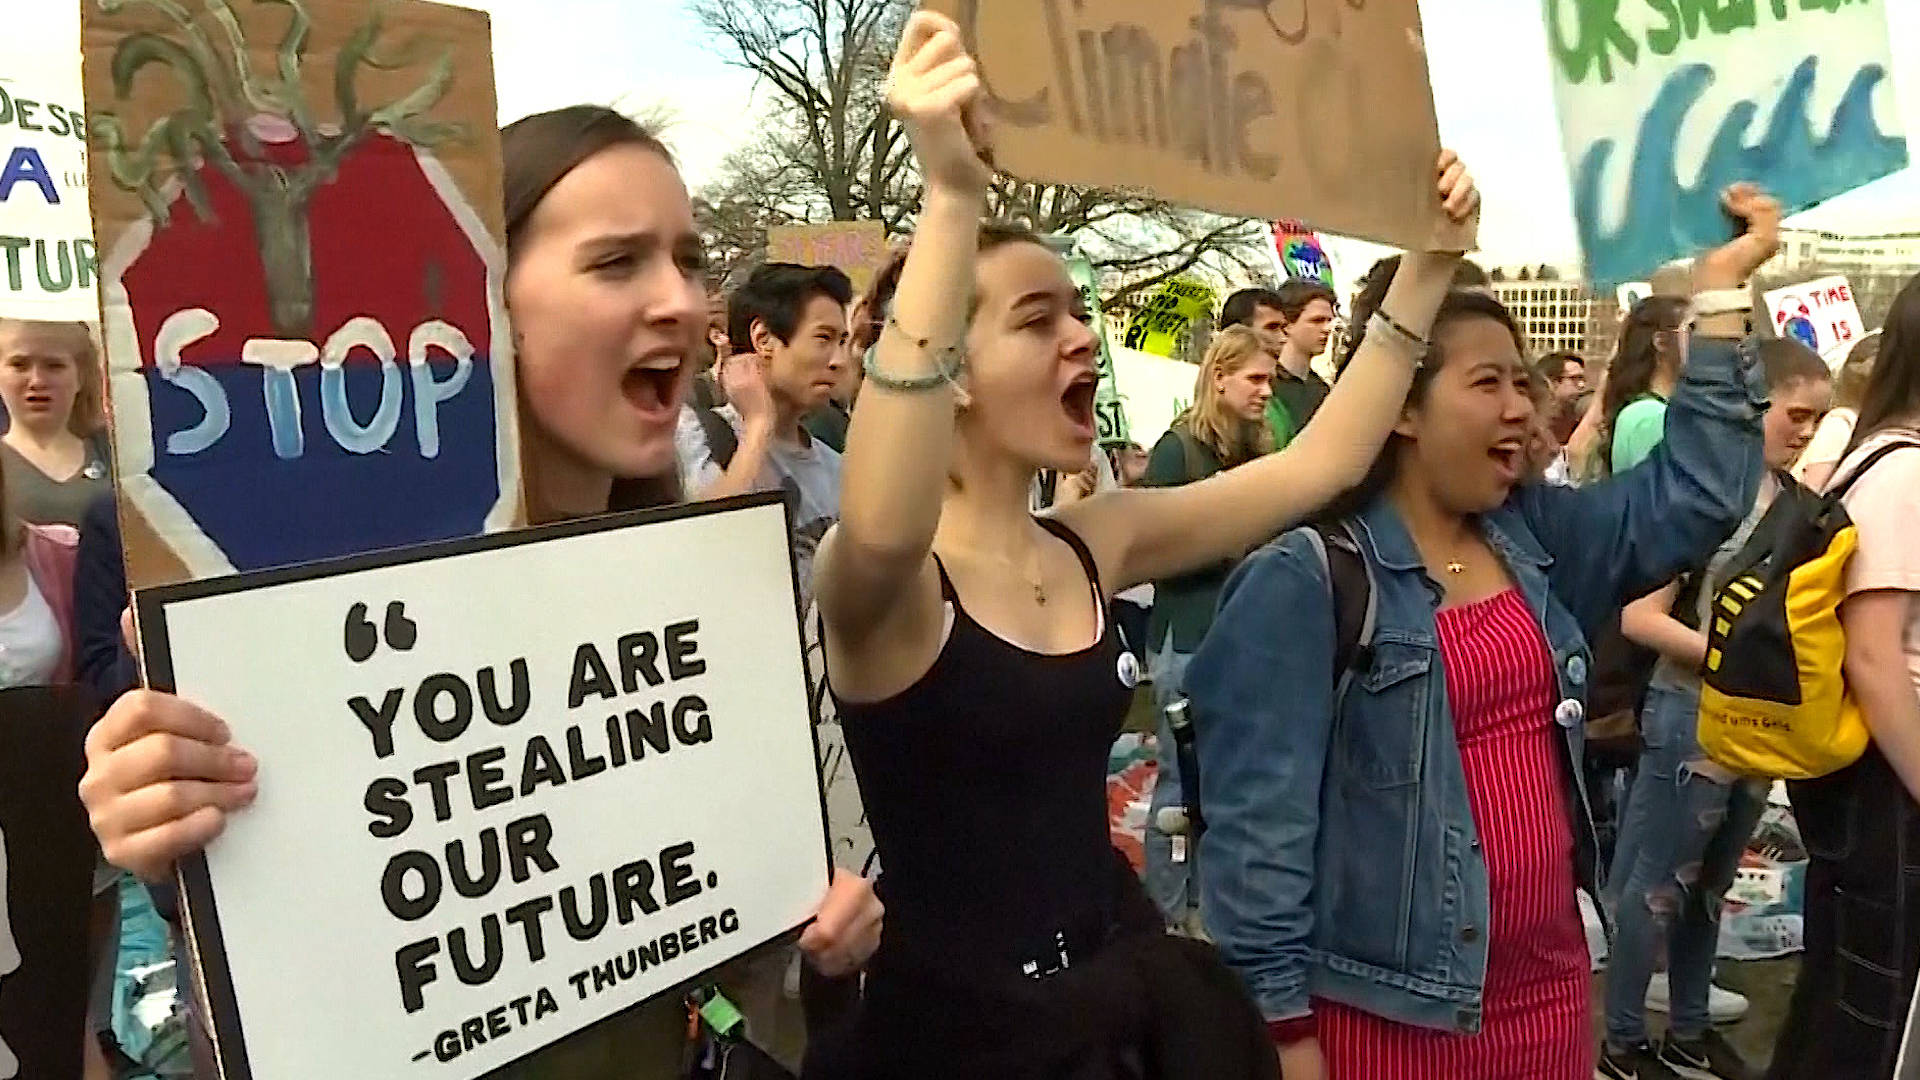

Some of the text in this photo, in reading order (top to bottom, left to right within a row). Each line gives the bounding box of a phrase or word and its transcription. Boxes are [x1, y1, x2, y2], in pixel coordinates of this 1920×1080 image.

[1809, 285, 1850, 309] TIME
[1831, 321, 1852, 342] IS
[154, 308, 475, 458] STOP
[347, 618, 707, 759] YOU ARE
[364, 695, 713, 838] STEALING
[381, 813, 560, 921] OUR
[395, 841, 718, 1014] FUTURE.
[568, 908, 740, 999] THUNBERG
